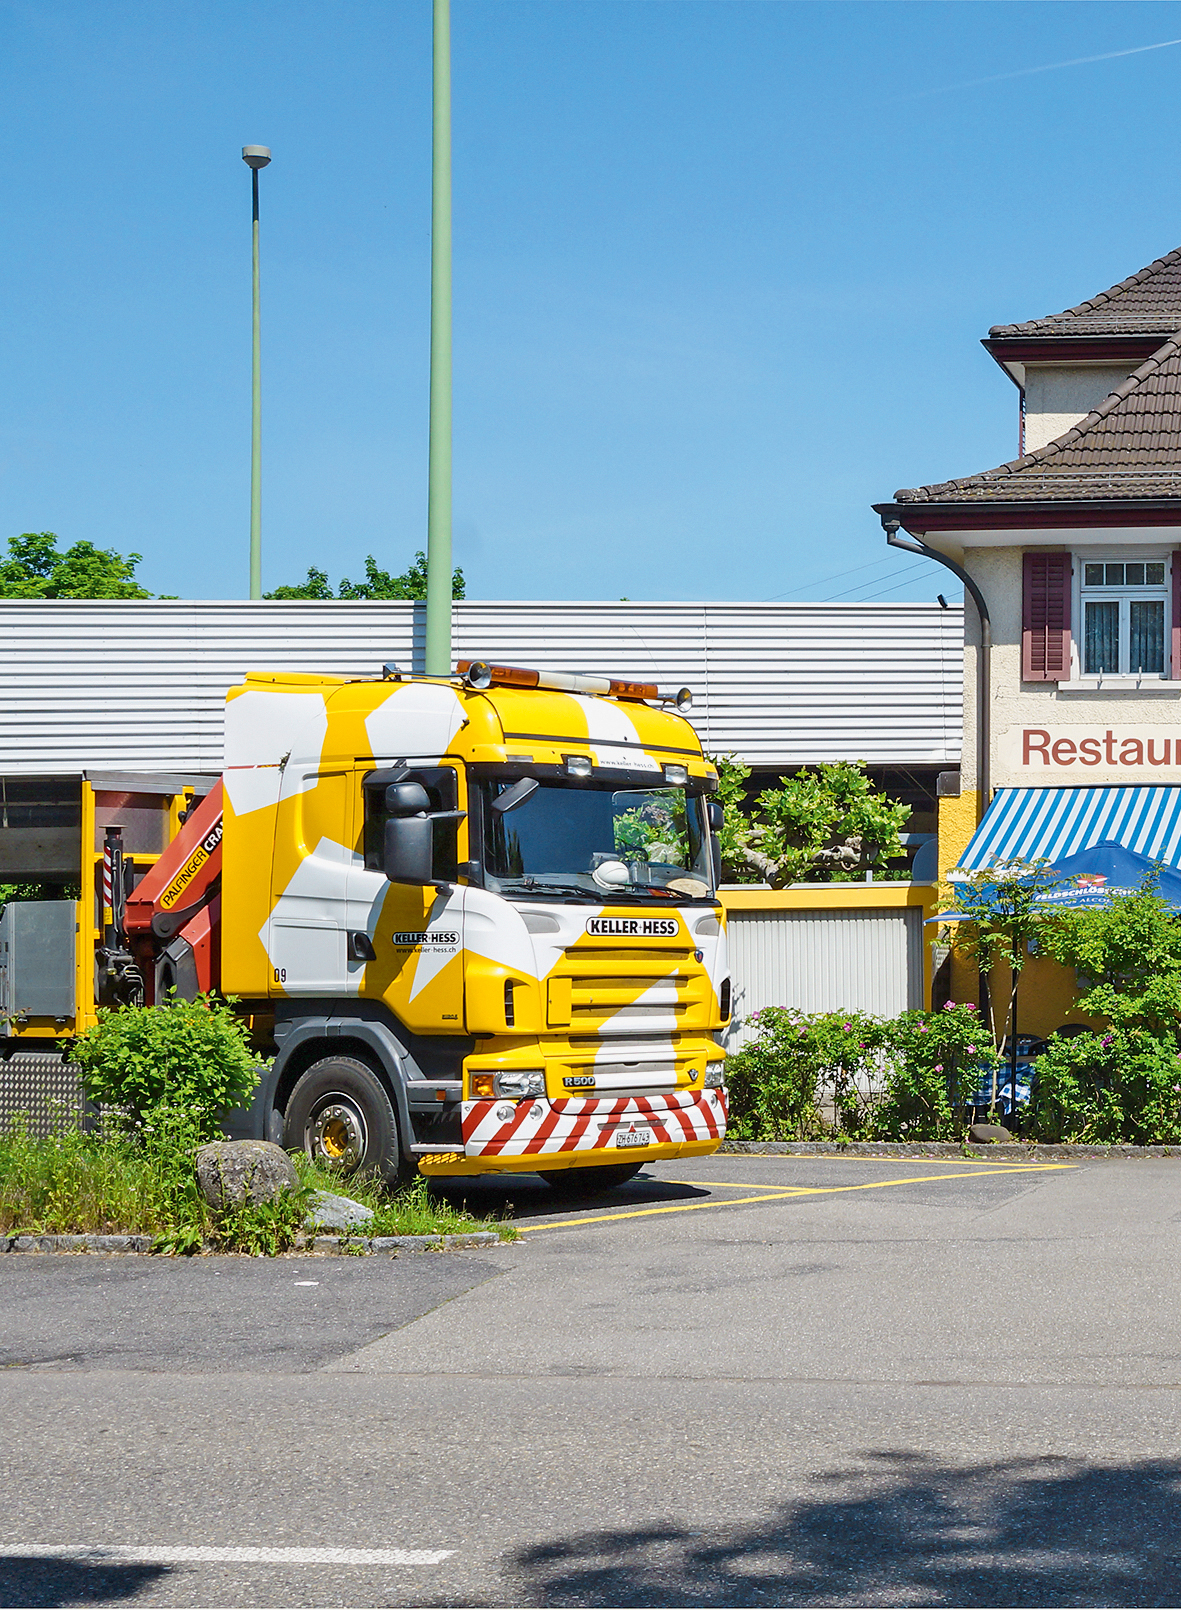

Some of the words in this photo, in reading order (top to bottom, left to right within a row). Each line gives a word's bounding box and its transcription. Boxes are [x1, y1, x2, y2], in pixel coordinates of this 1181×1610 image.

[162, 850, 207, 906] PALFINGER
[204, 822, 223, 851] CRA
[273, 967, 287, 983] 09
[618, 1134, 626, 1144] ZH
